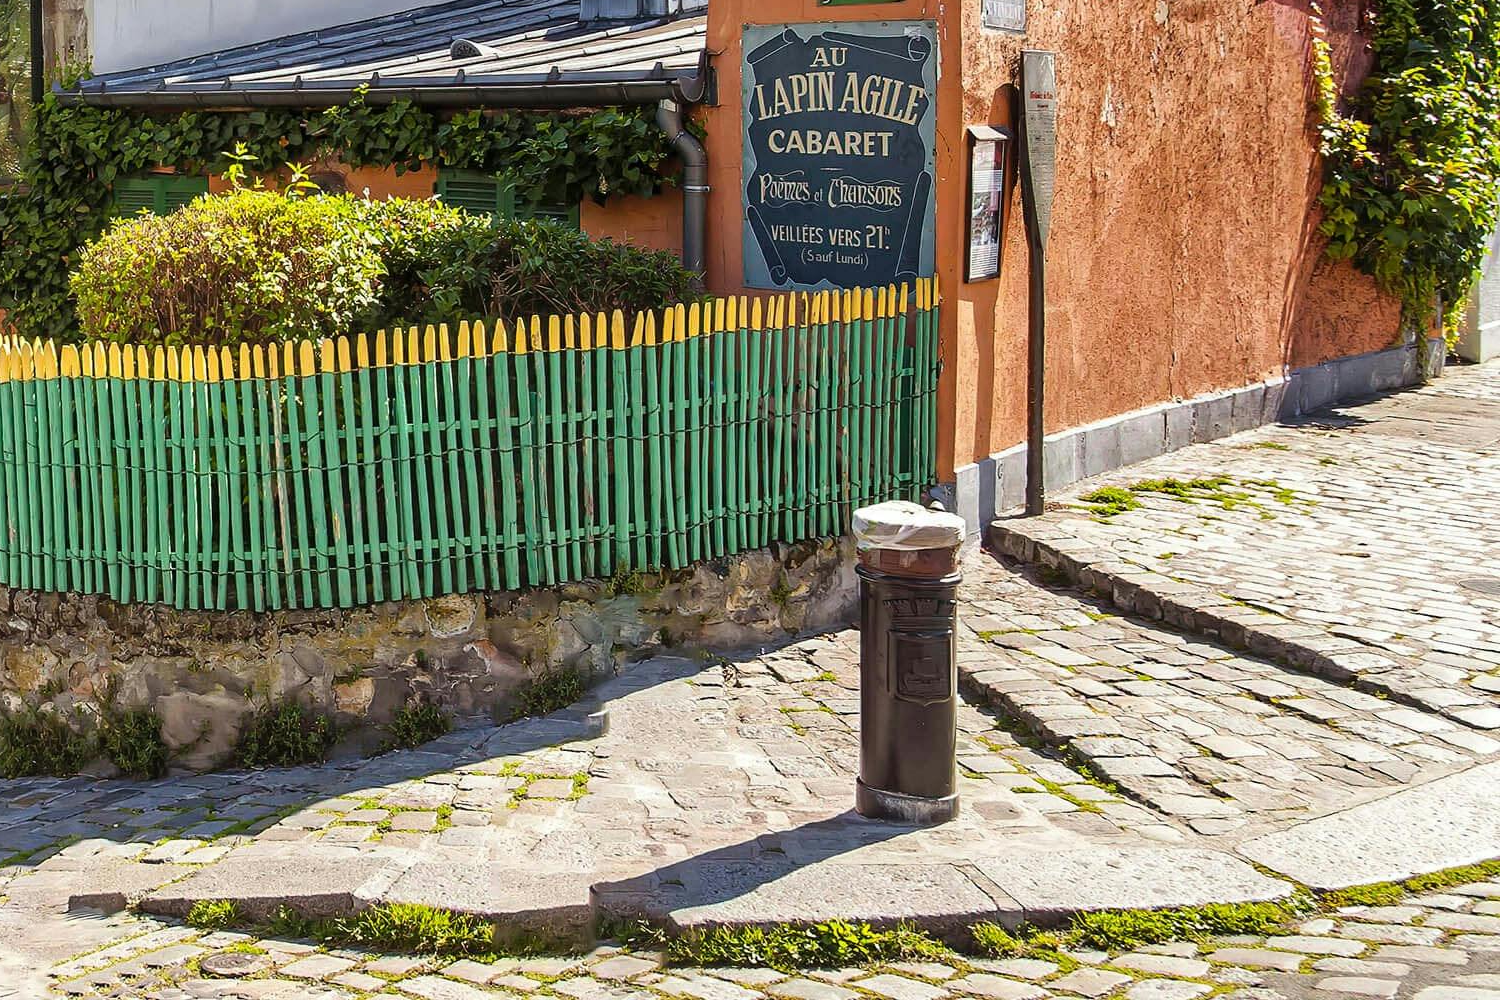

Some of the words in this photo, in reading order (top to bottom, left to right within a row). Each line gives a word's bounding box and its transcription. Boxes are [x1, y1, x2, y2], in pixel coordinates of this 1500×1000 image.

[809, 47, 848, 68] AU
[755, 71, 836, 121] LAPIN
[838, 72, 925, 126] AGILE
[768, 129, 893, 157] CABARET
[759, 173, 810, 203] Poèmes
[813, 188, 823, 202] et
[827, 178, 902, 208] Chansons
[771, 224, 824, 244] VEILLÉES
[829, 228, 861, 248] VERS
[801, 247, 834, 265] (Sauf
[836, 251, 869, 271] Lundi)
